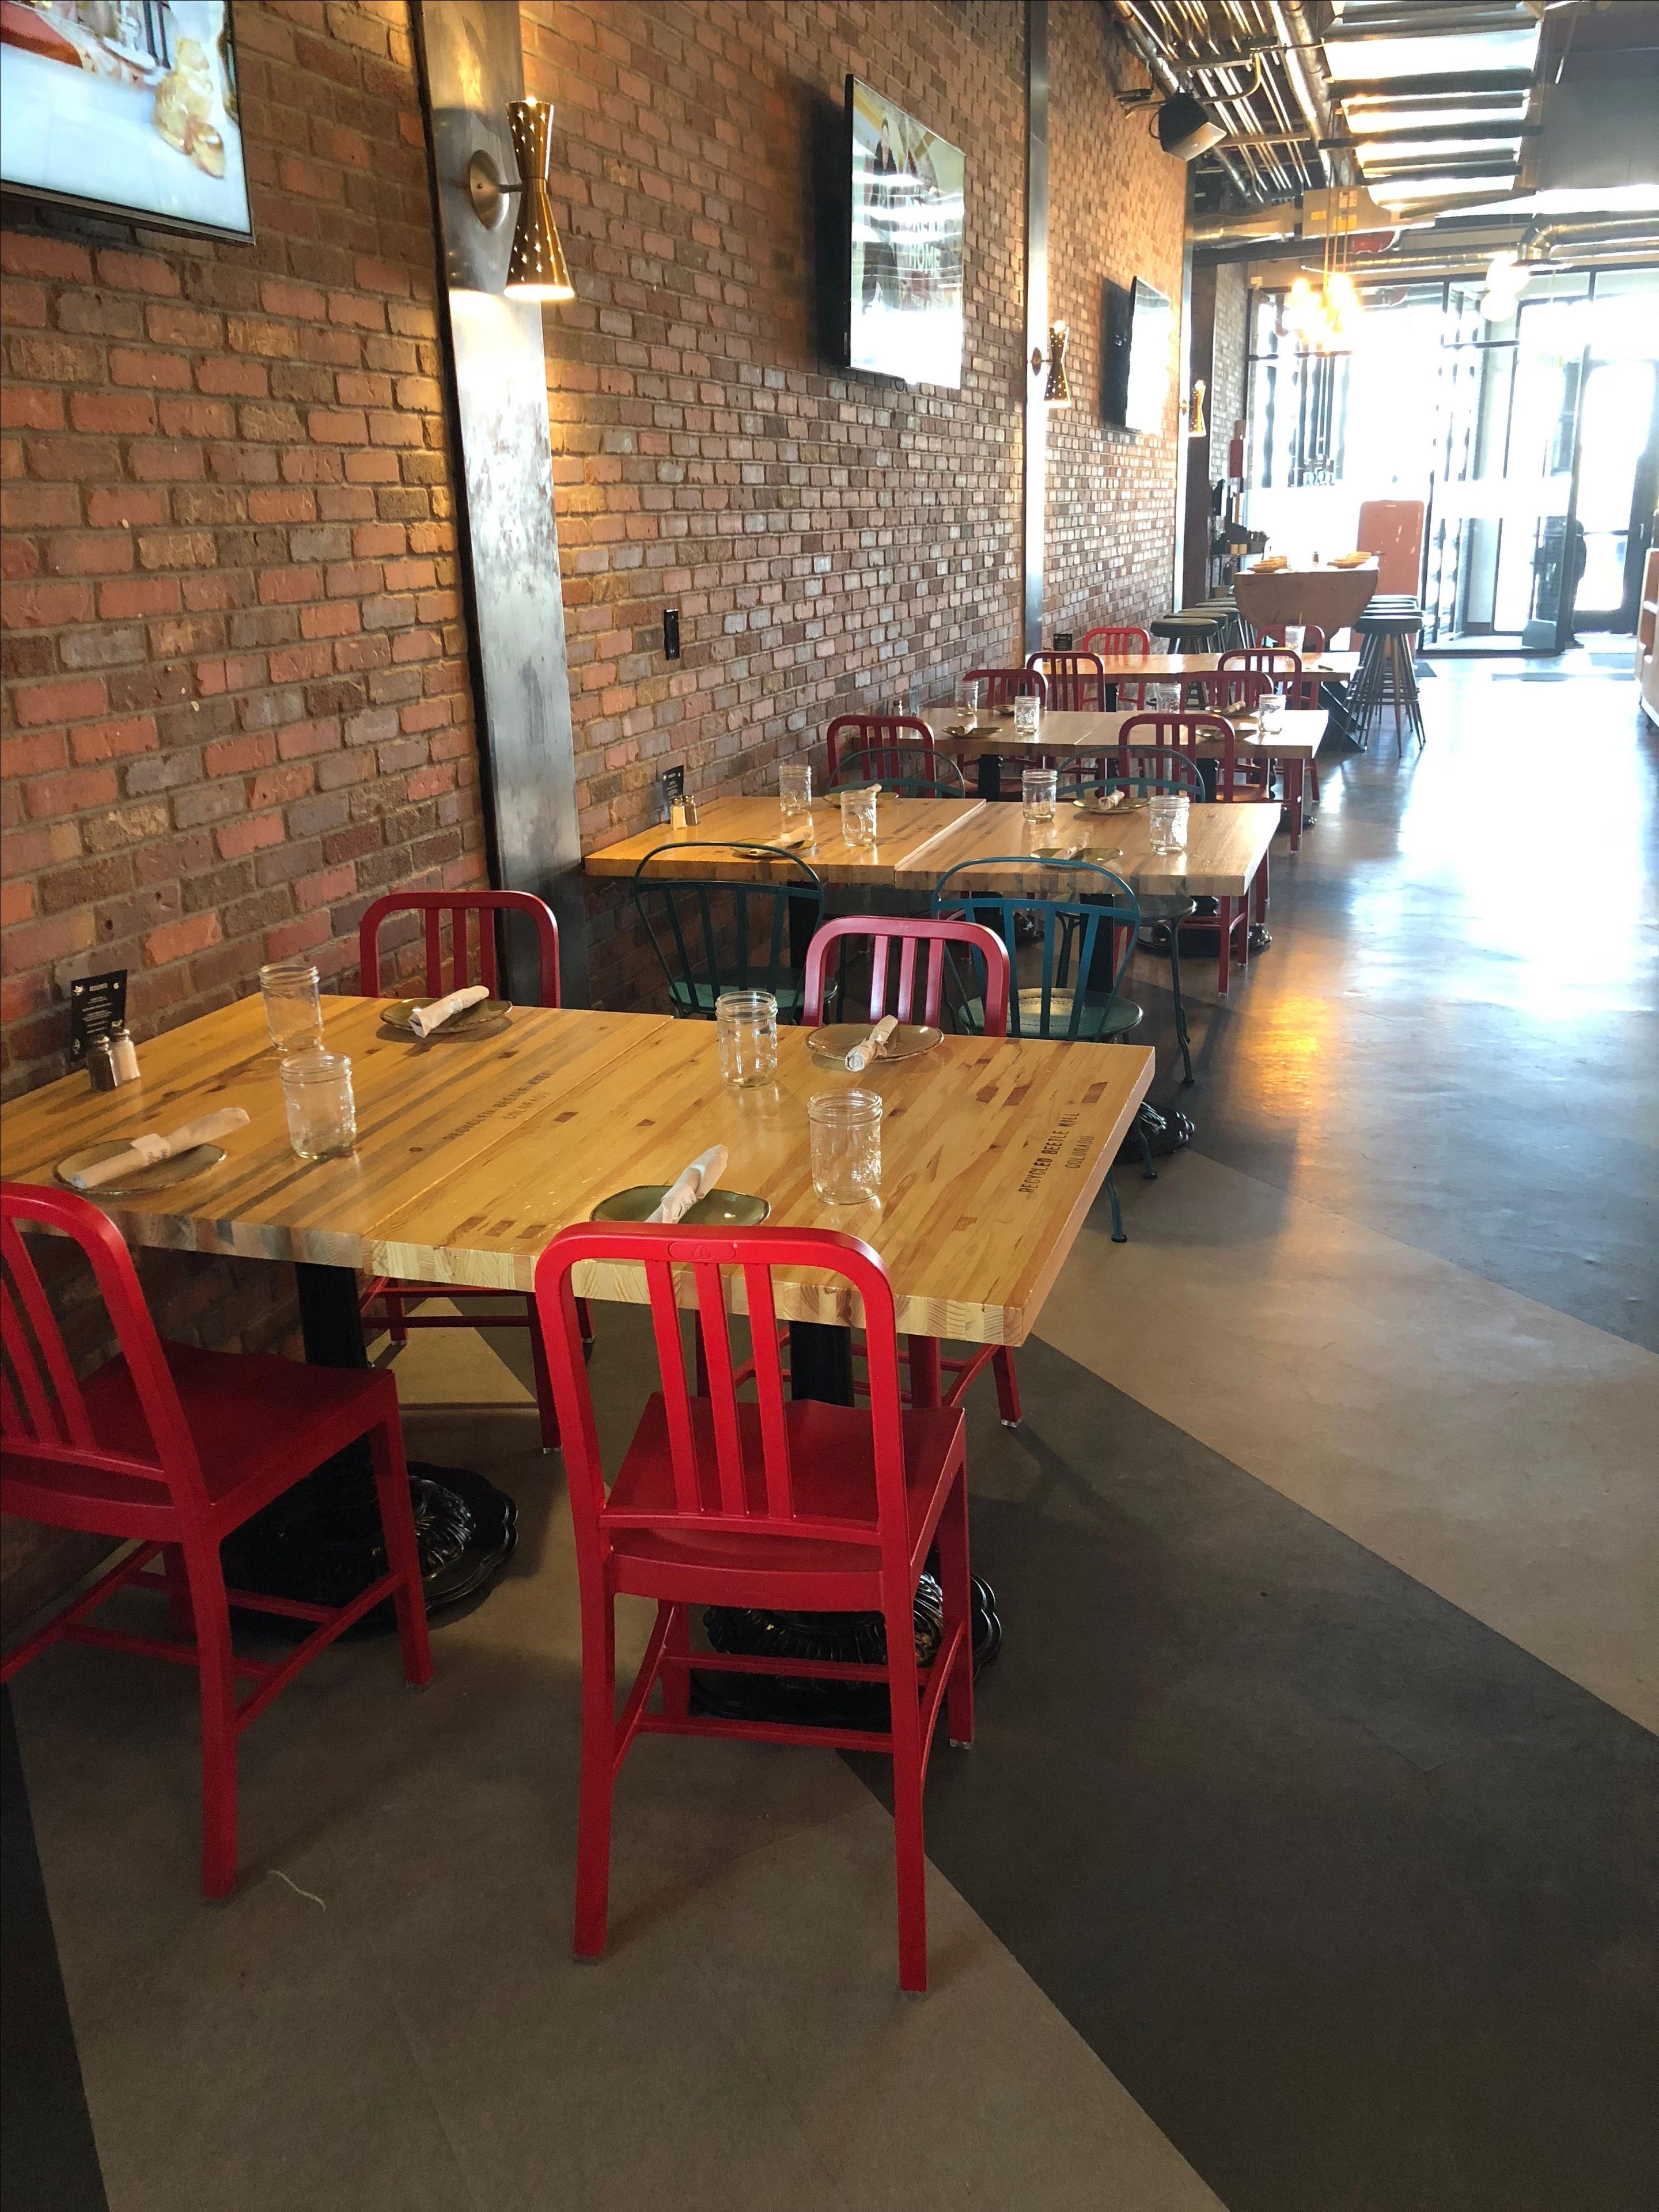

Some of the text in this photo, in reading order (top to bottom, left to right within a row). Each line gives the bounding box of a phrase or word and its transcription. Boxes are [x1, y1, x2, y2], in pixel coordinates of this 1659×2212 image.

[1018, 1112, 1080, 1193] RECYCLED BEETLE KILL
[1065, 1135, 1095, 1169] COLORADO
